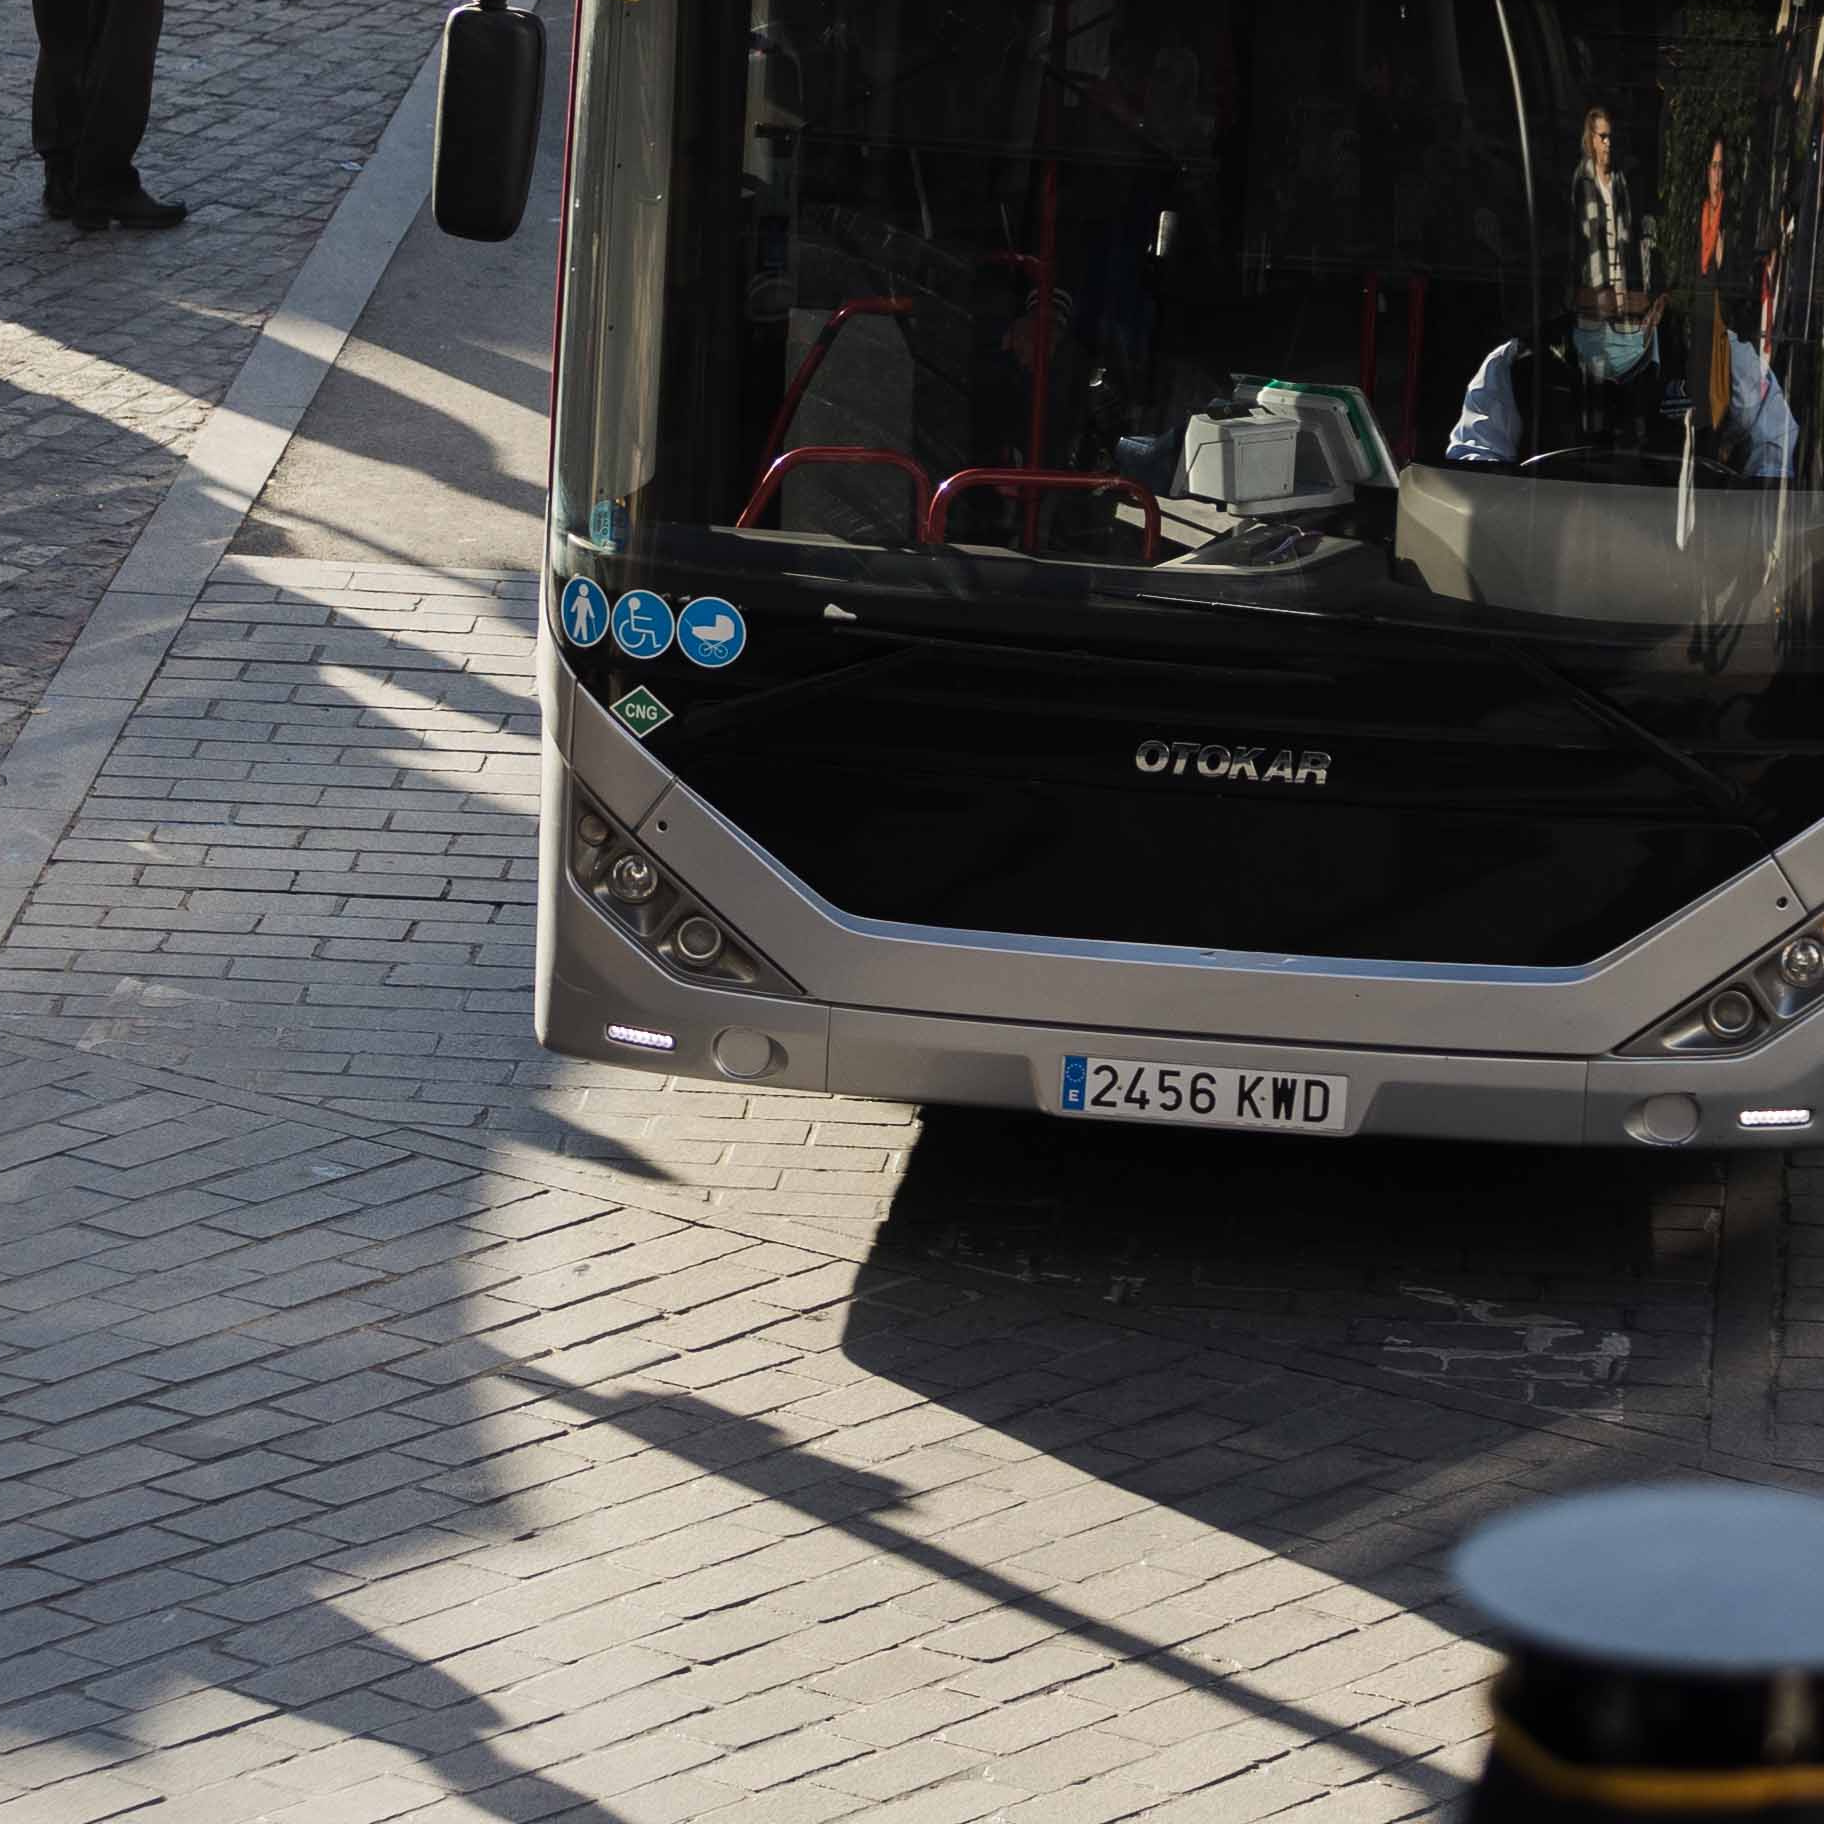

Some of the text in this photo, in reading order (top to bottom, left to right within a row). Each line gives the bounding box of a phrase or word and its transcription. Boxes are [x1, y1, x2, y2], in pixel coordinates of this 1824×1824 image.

[625, 702, 658, 721] CNG
[1135, 739, 1333, 785] OTOKAR
[1090, 1064, 1218, 1115] 2456
[1236, 1074, 1332, 1123] KWD
